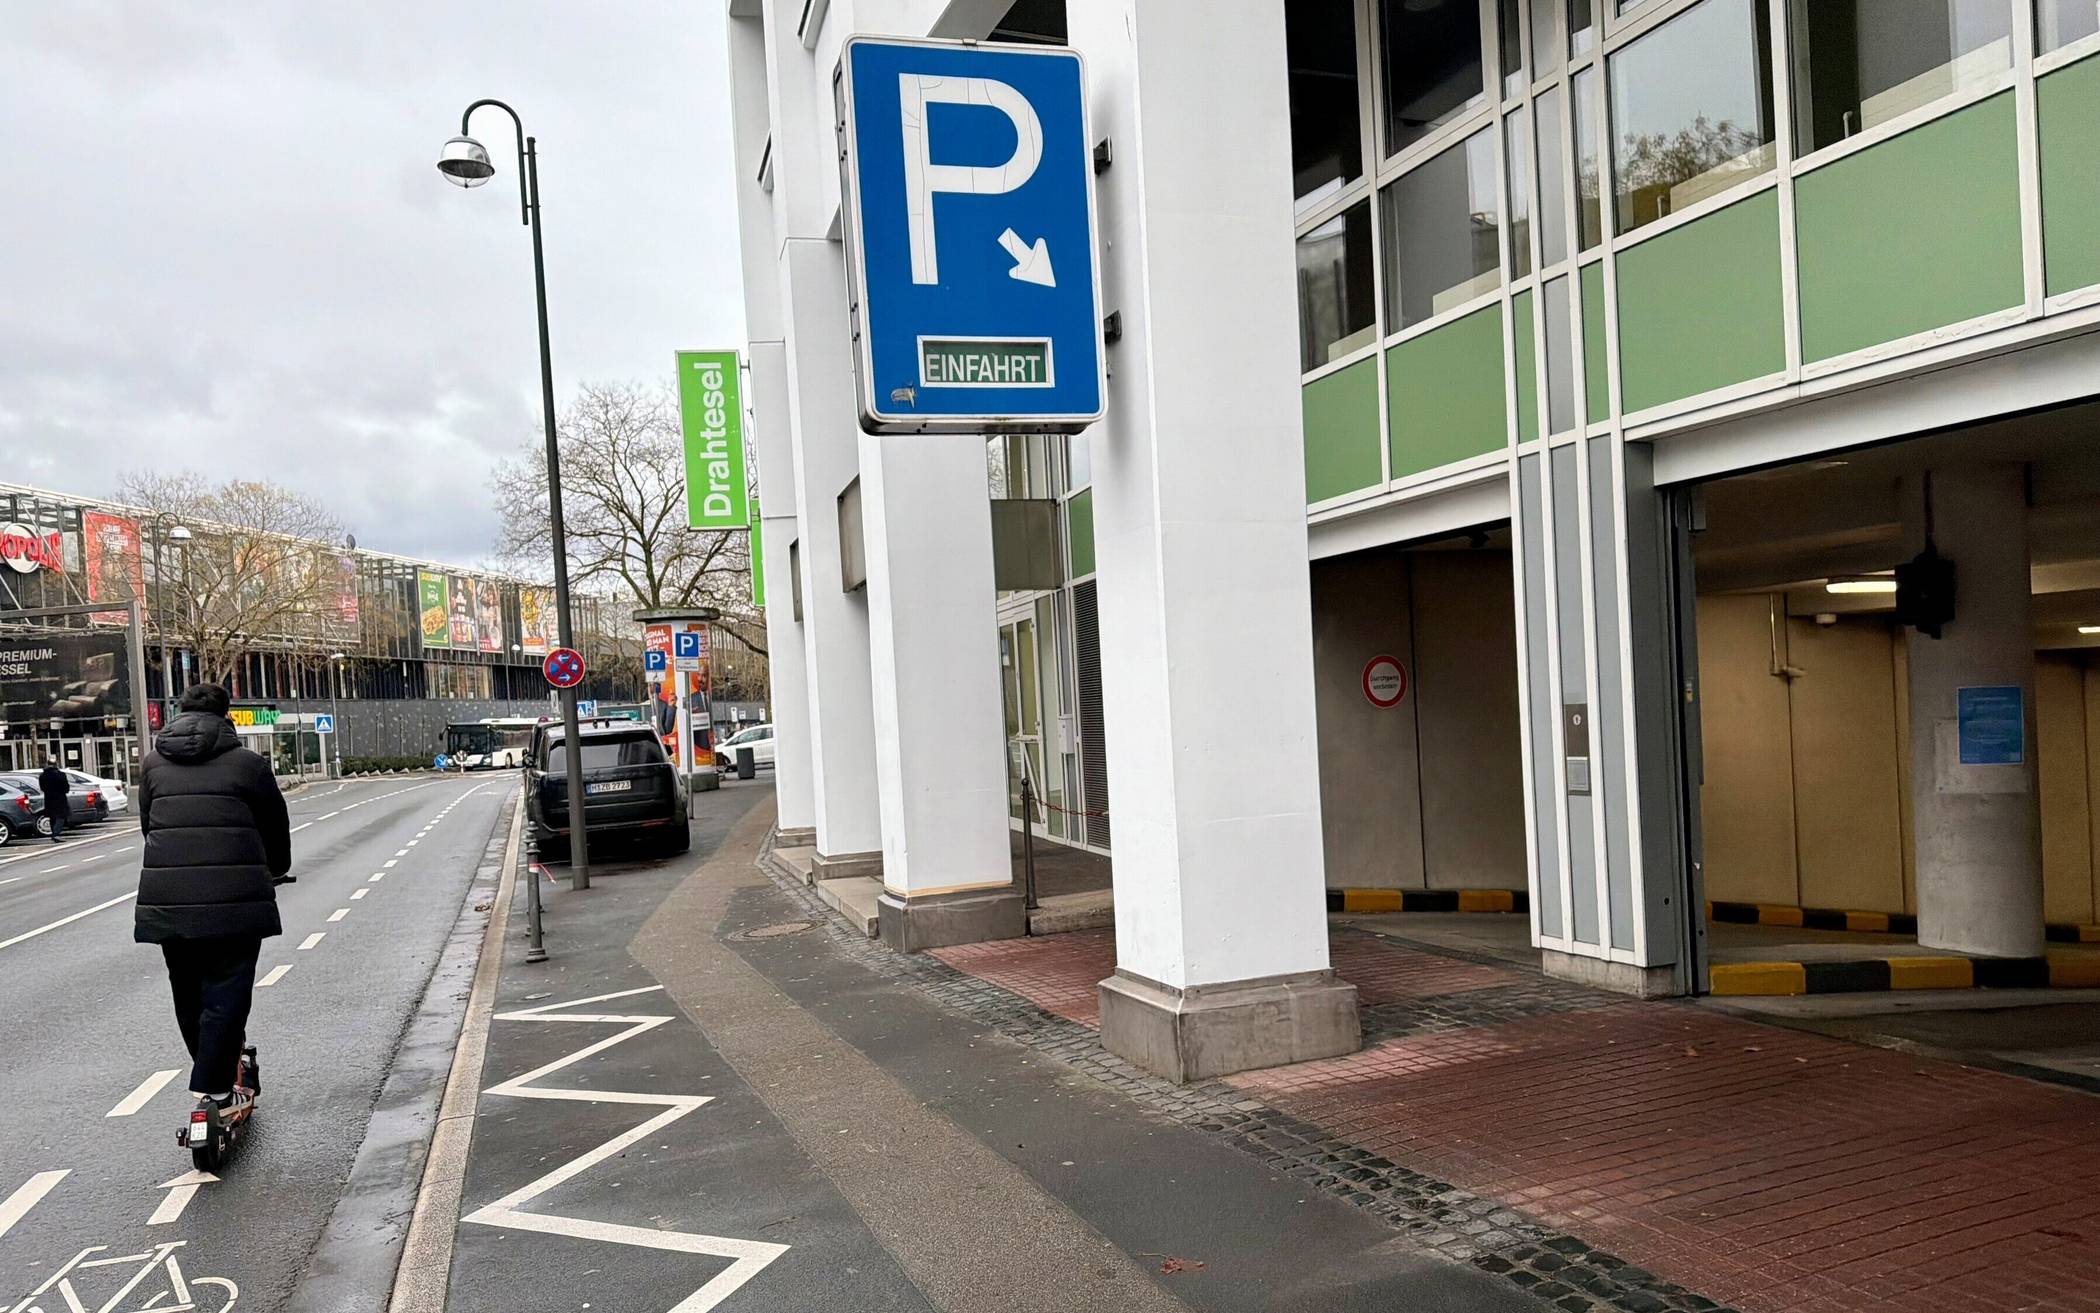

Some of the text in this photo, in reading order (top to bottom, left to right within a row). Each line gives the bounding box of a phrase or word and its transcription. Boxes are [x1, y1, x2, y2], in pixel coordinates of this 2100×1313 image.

[899, 73, 1043, 285] P
[925, 353, 1041, 383] EINFAHRT
[693, 362, 732, 517] Drahtesel
[680, 635, 694, 655] P
[0, 662, 32, 676] SSEL
[649, 653, 661, 669] P
[231, 709, 281, 726] SUBWAY
